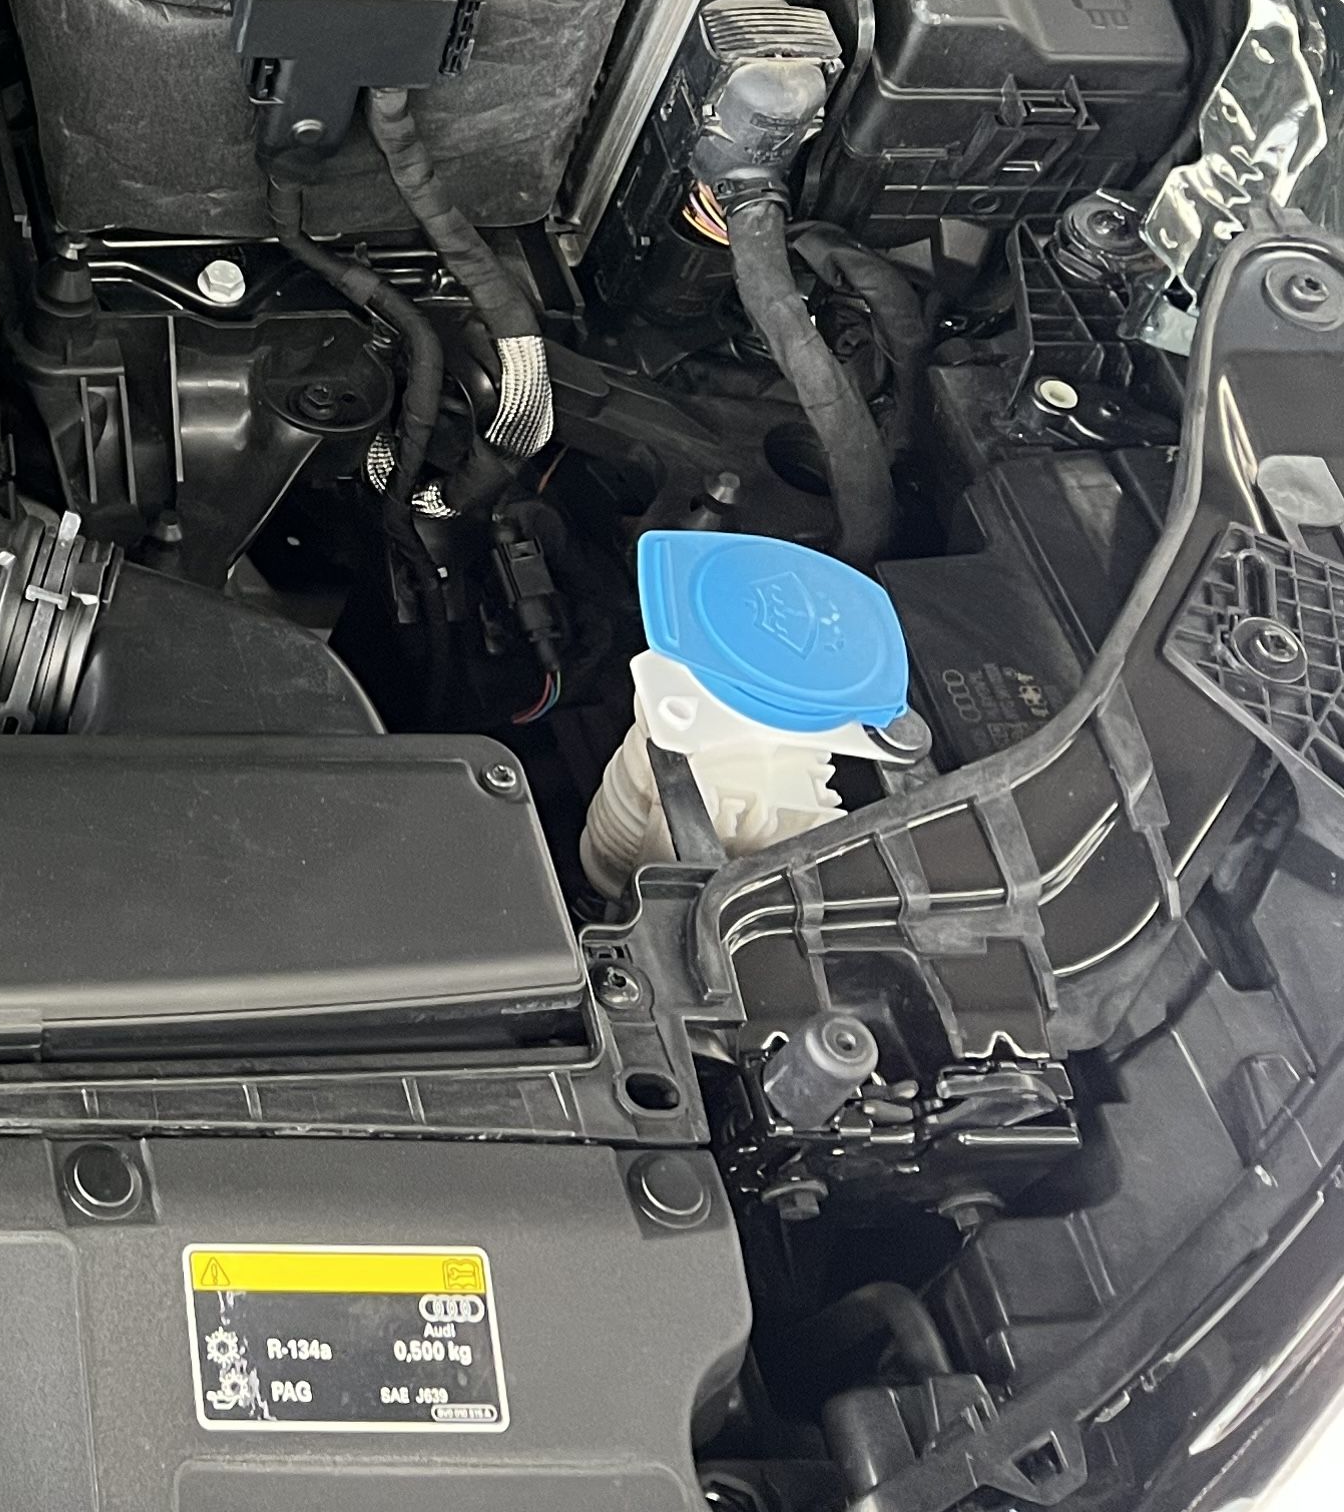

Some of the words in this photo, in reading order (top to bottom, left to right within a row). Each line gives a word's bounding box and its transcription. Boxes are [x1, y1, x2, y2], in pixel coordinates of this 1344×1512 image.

[423, 1322, 456, 1338] Audi
[266, 1338, 333, 1361] R-134a
[393, 1340, 445, 1364] 0,500
[447, 1340, 473, 1366] kg
[271, 1381, 313, 1403] PAG
[380, 1386, 410, 1404] SAE
[415, 1386, 449, 1404] J639
